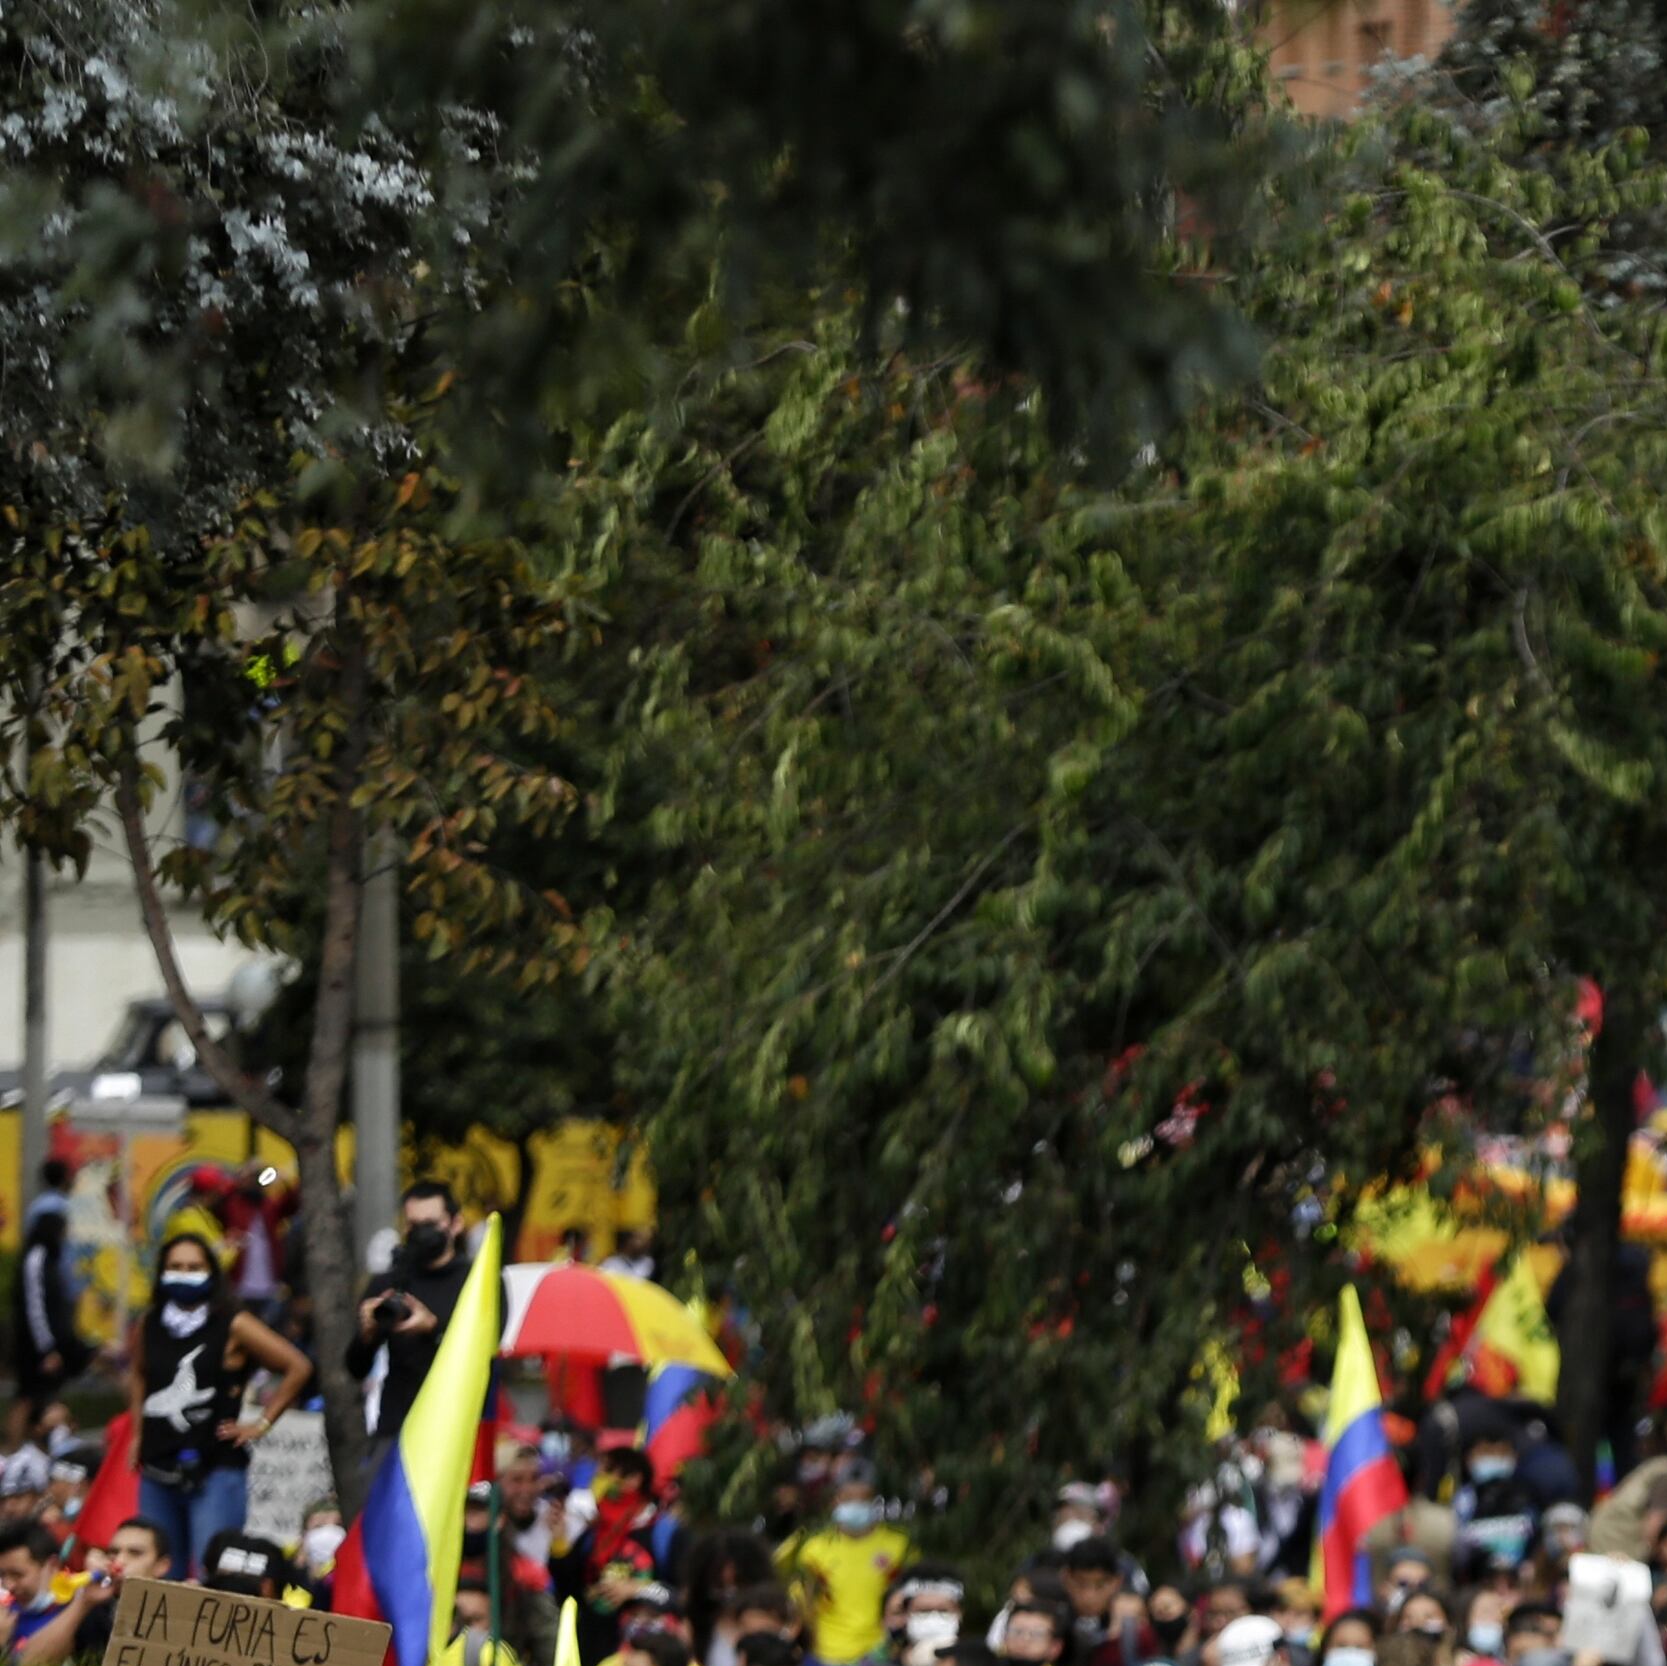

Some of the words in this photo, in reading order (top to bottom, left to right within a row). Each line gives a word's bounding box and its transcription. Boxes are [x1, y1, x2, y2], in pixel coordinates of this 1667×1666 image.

[133, 1590, 168, 1641] LA
[191, 1597, 276, 1662] FURIA
[292, 1617, 338, 1666] ES
